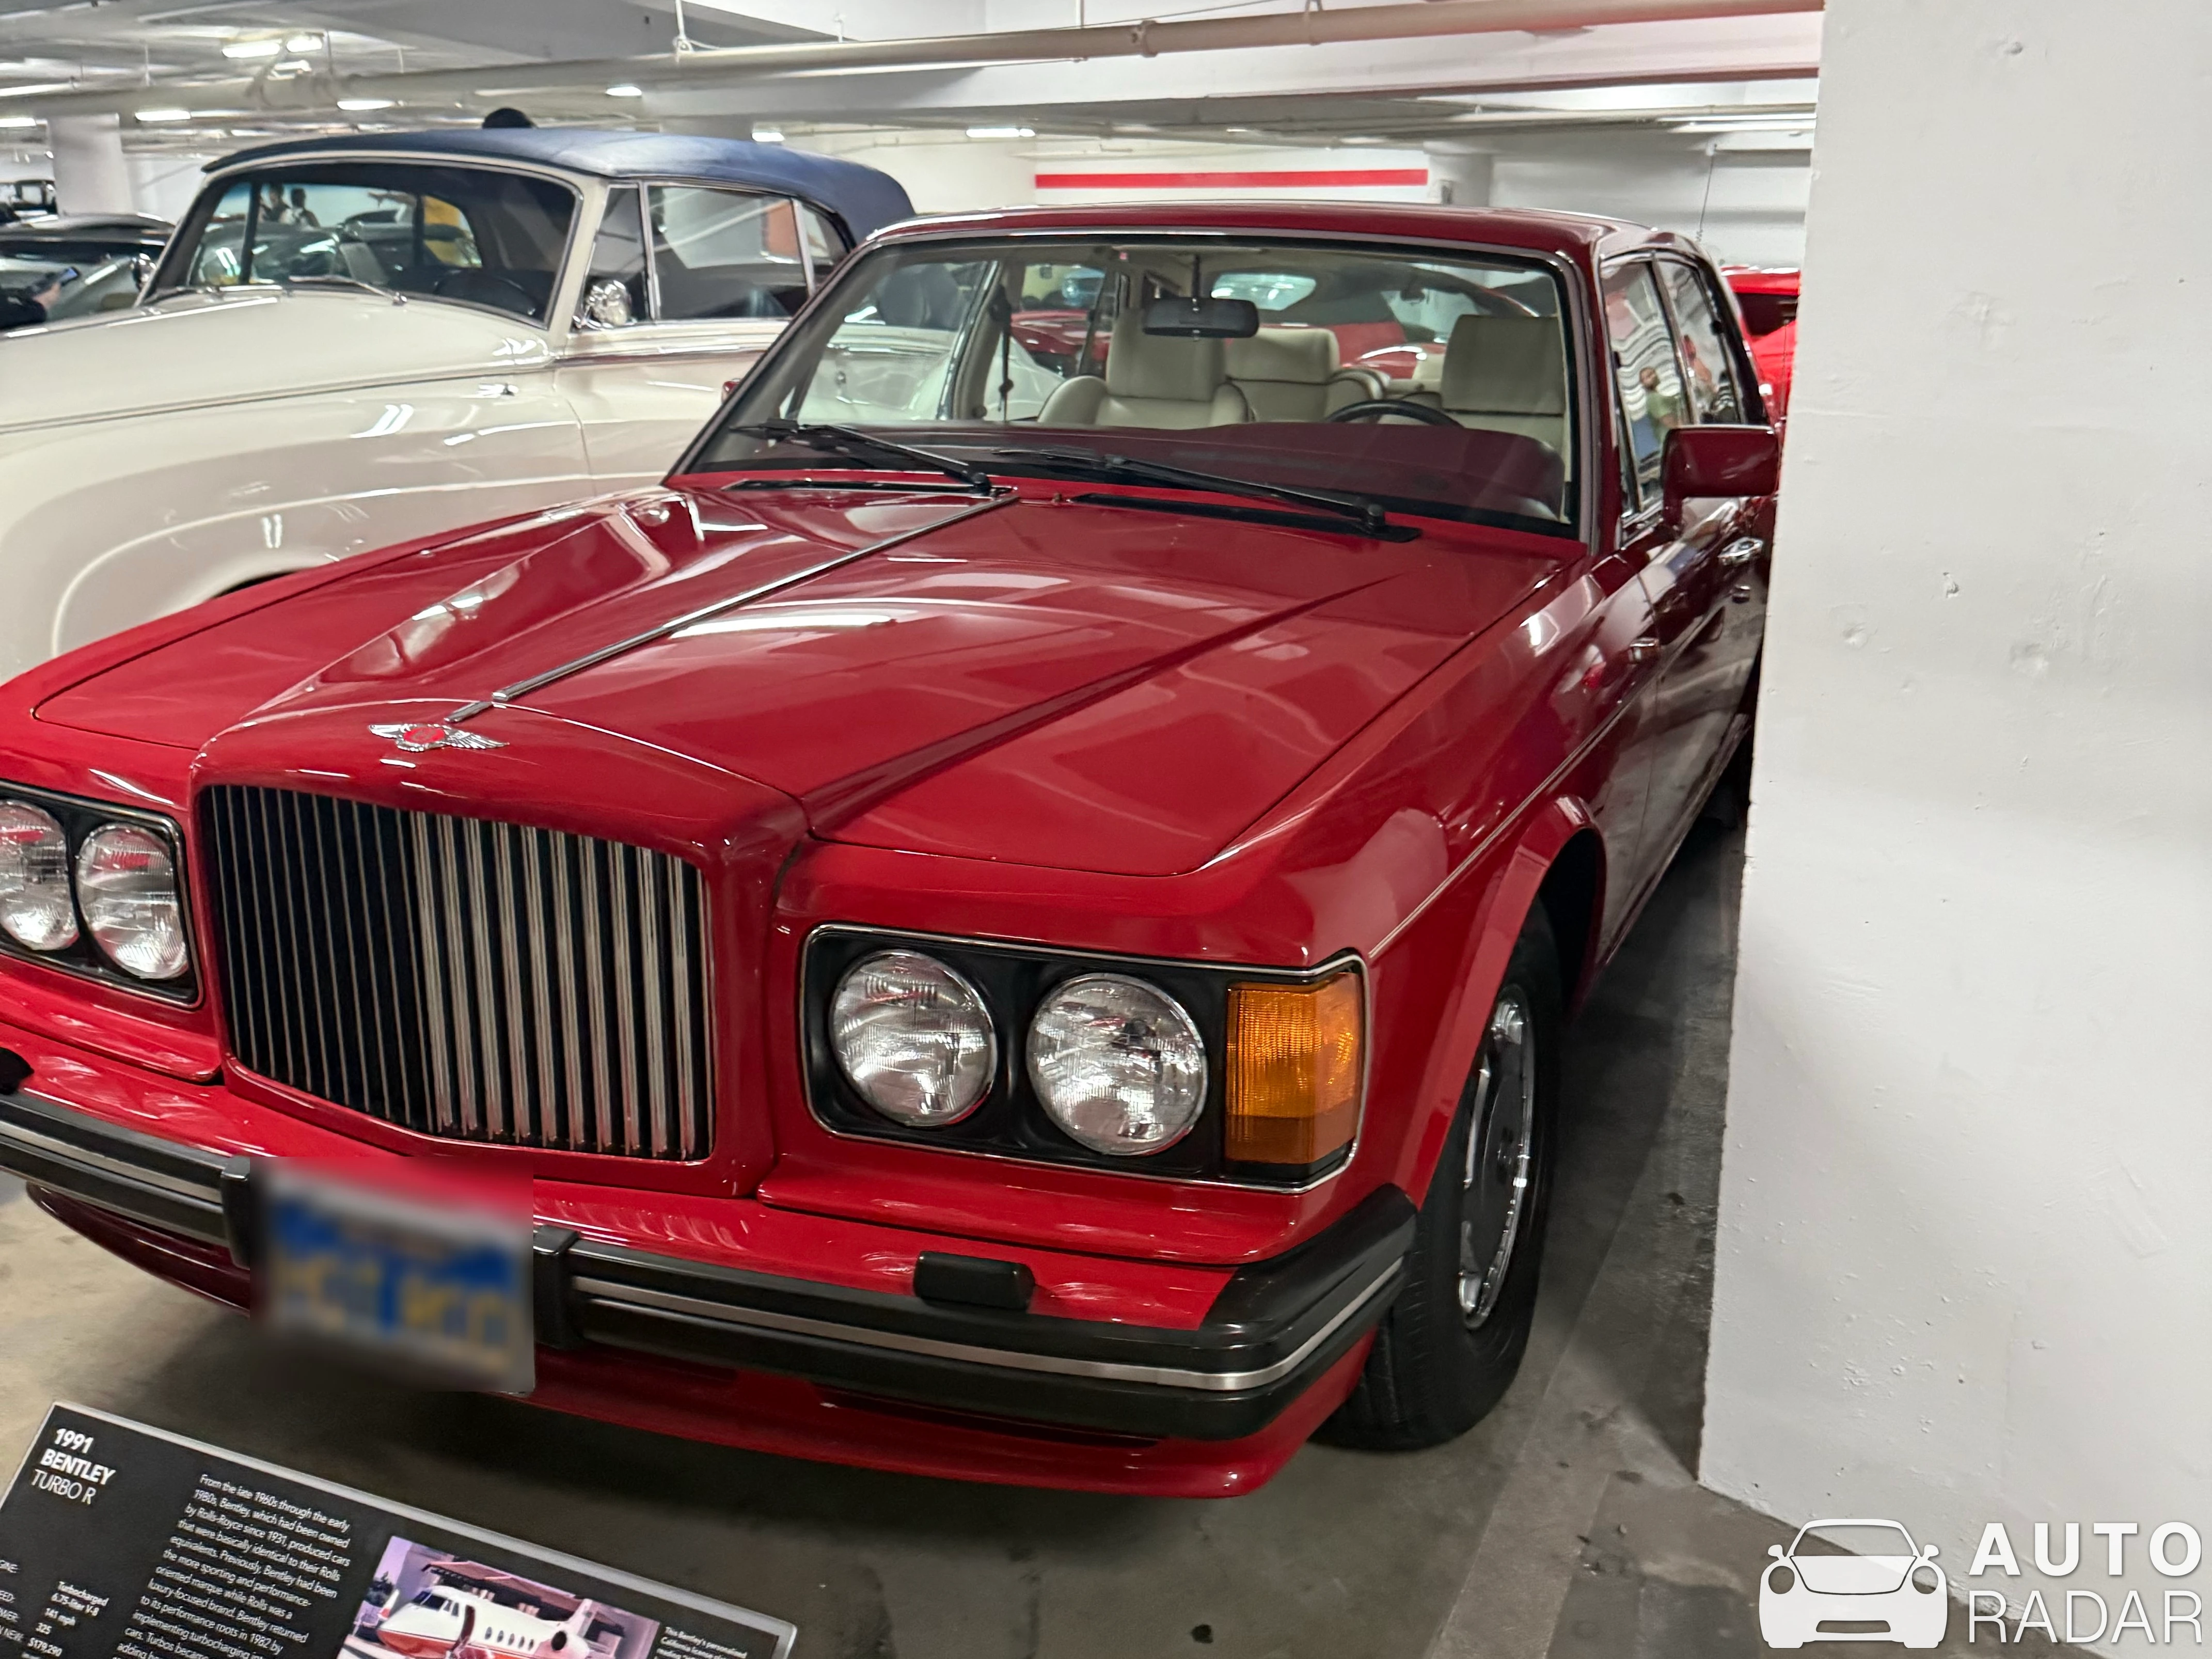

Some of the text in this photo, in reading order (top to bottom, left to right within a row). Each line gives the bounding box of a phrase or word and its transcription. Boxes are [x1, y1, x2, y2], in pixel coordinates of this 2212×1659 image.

[54, 1428, 94, 1454] 1991
[40, 1448, 116, 1485] BENTLEY
[31, 1468, 97, 1505] TURBO R
[199, 1474, 223, 1489] From
[222, 1481, 237, 1494] the
[254, 1492, 279, 1507] 1960s
[277, 1499, 312, 1519] through
[311, 1511, 328, 1523] the
[327, 1518, 350, 1533] early
[184, 1503, 197, 1518] by
[196, 1507, 244, 1530] Rolls-Royce
[243, 1524, 266, 1538] since
[287, 1540, 333, 1560] produced
[330, 1555, 351, 1567] cars
[252, 1510, 277, 1524] which
[277, 1516, 297, 1530] had
[294, 1522, 319, 1538] been
[318, 1532, 351, 1549] owned
[178, 1519, 341, 1582] that were basically identical to their Rolls
[56, 1581, 109, 1606] Turbocharged
[155, 1566, 293, 1620] oriented marque while Rolls was a
[163, 1549, 312, 1607] the more sporting and performance-
[262, 1565, 297, 1586] Bentley
[295, 1575, 315, 1590] had
[312, 1581, 338, 1598] been
[35, 1622, 52, 1635] 325
[57, 1615, 76, 1626] mph
[85, 1604, 100, 1616] V-8
[140, 1595, 283, 1655] to its performance roots in 1982 by
[147, 1577, 210, 1608] luxury-focused
[235, 1609, 271, 1632] Bentley
[268, 1624, 309, 1643] returned
[132, 1609, 190, 1640] implementing
[188, 1631, 250, 1659] turbocharging
[146, 1632, 175, 1651] Turbos
